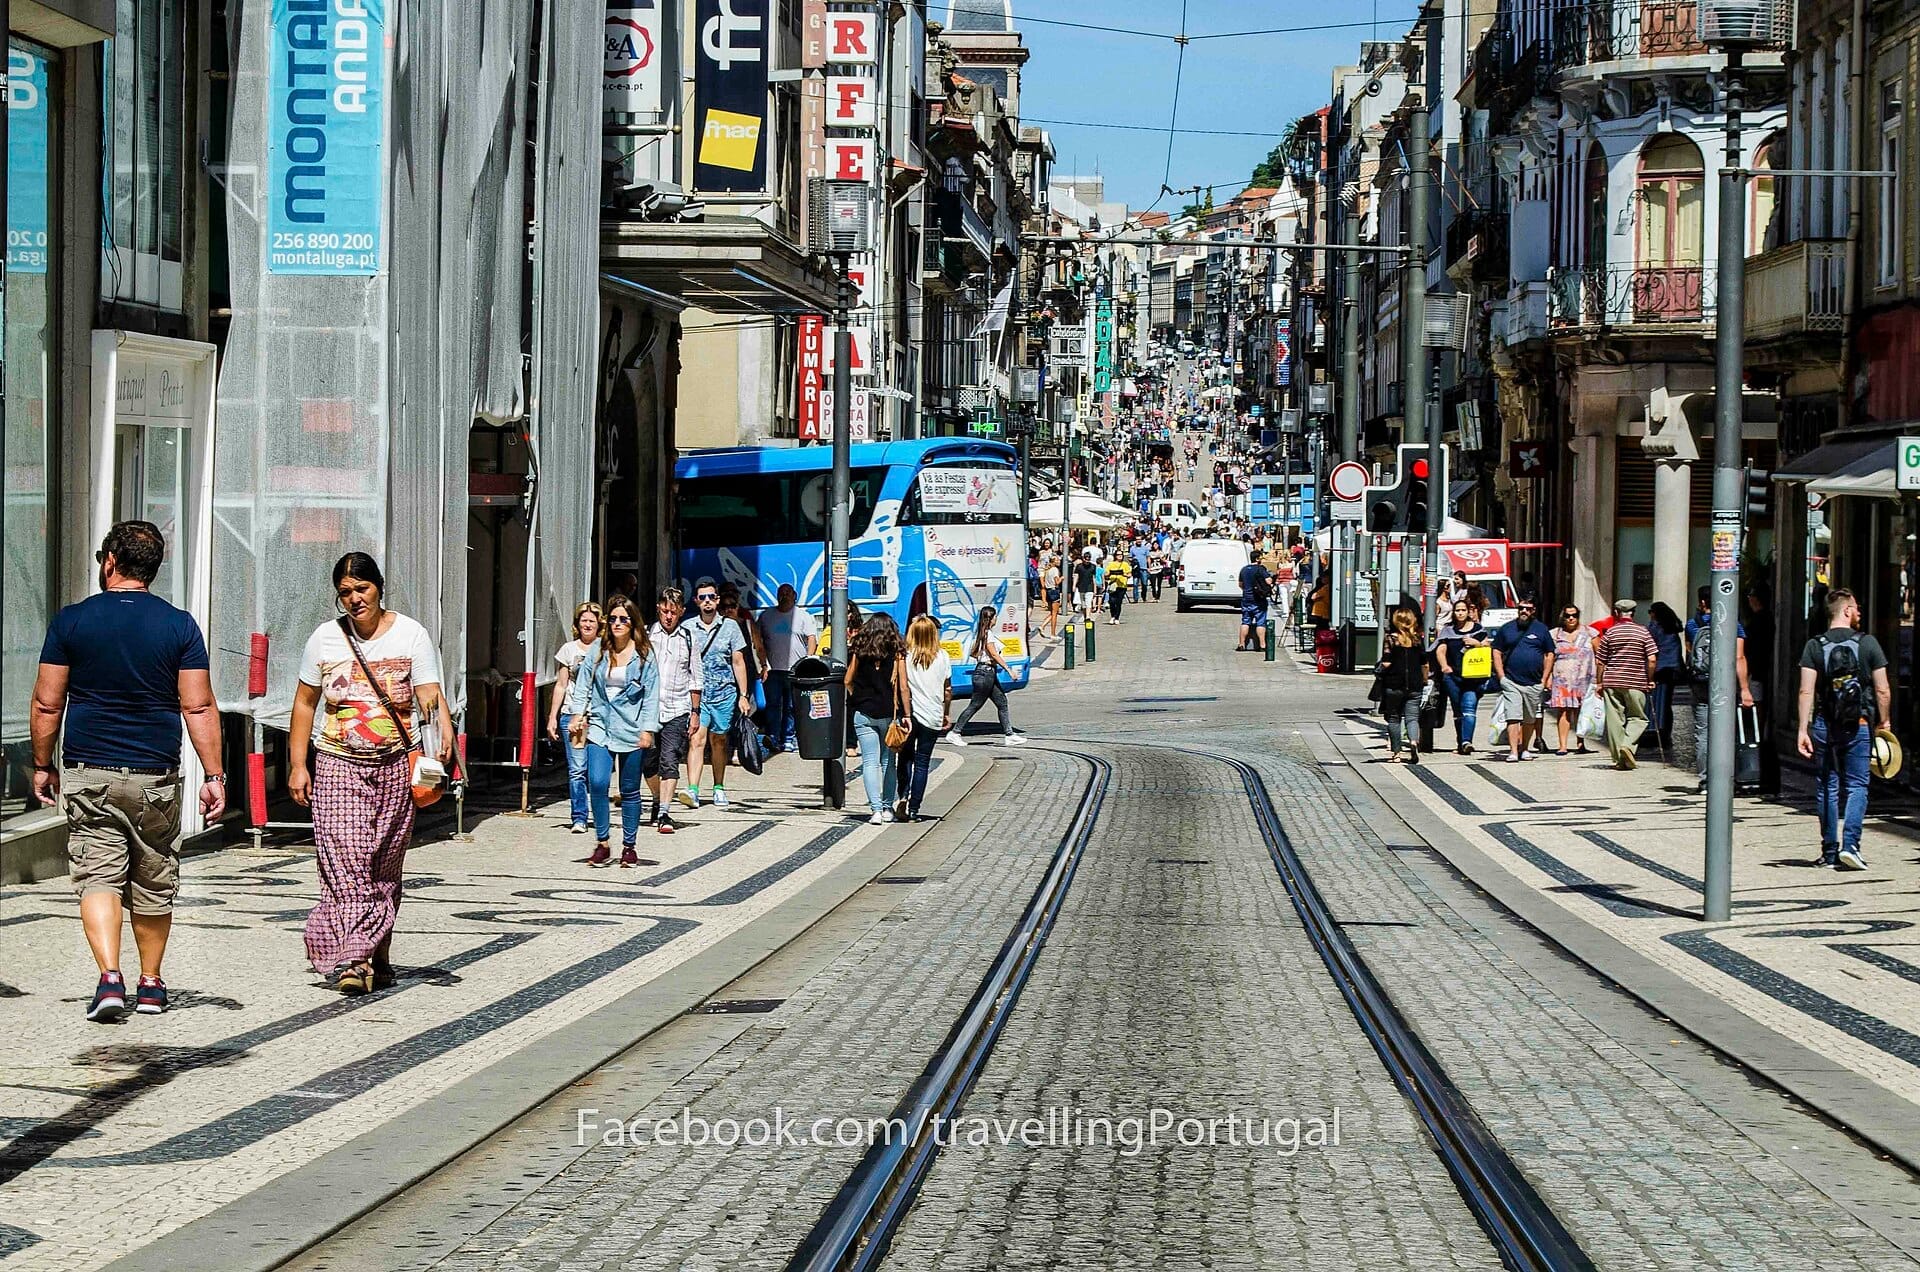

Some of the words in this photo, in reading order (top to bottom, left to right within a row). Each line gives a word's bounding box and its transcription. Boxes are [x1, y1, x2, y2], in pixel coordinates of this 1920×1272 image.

[605, 34, 640, 60] &A
[705, 119, 760, 139] fnac
[273, 233, 305, 249] 256
[307, 233, 339, 250] 890
[343, 234, 374, 250] 200
[272, 251, 375, 269] montaluga.pt
[803, 318, 819, 436] FUMARIA
[824, 394, 864, 406] OO
[823, 408, 864, 421] PTA
[933, 543, 956, 559] Rede
